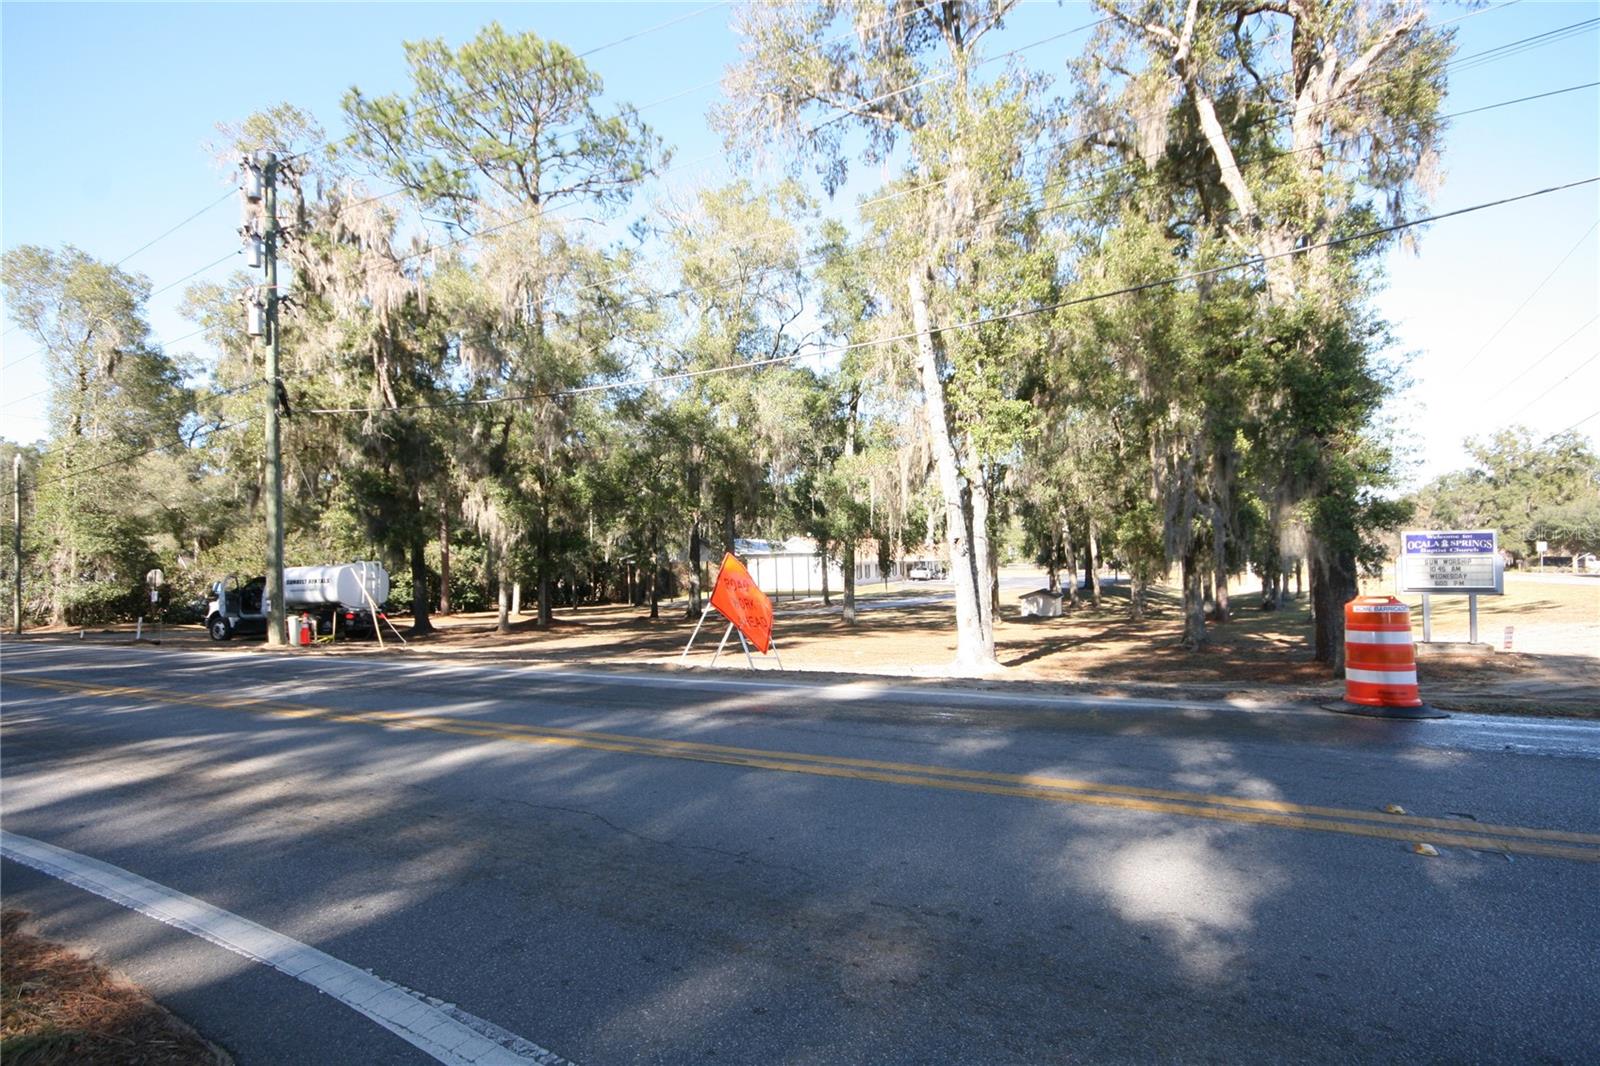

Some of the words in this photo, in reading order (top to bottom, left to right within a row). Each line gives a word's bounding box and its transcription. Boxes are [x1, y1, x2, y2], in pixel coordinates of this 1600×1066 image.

[1407, 541, 1439, 550] OCALA
[1450, 539, 1492, 548] SPRINGS
[724, 578, 749, 592] ROAD
